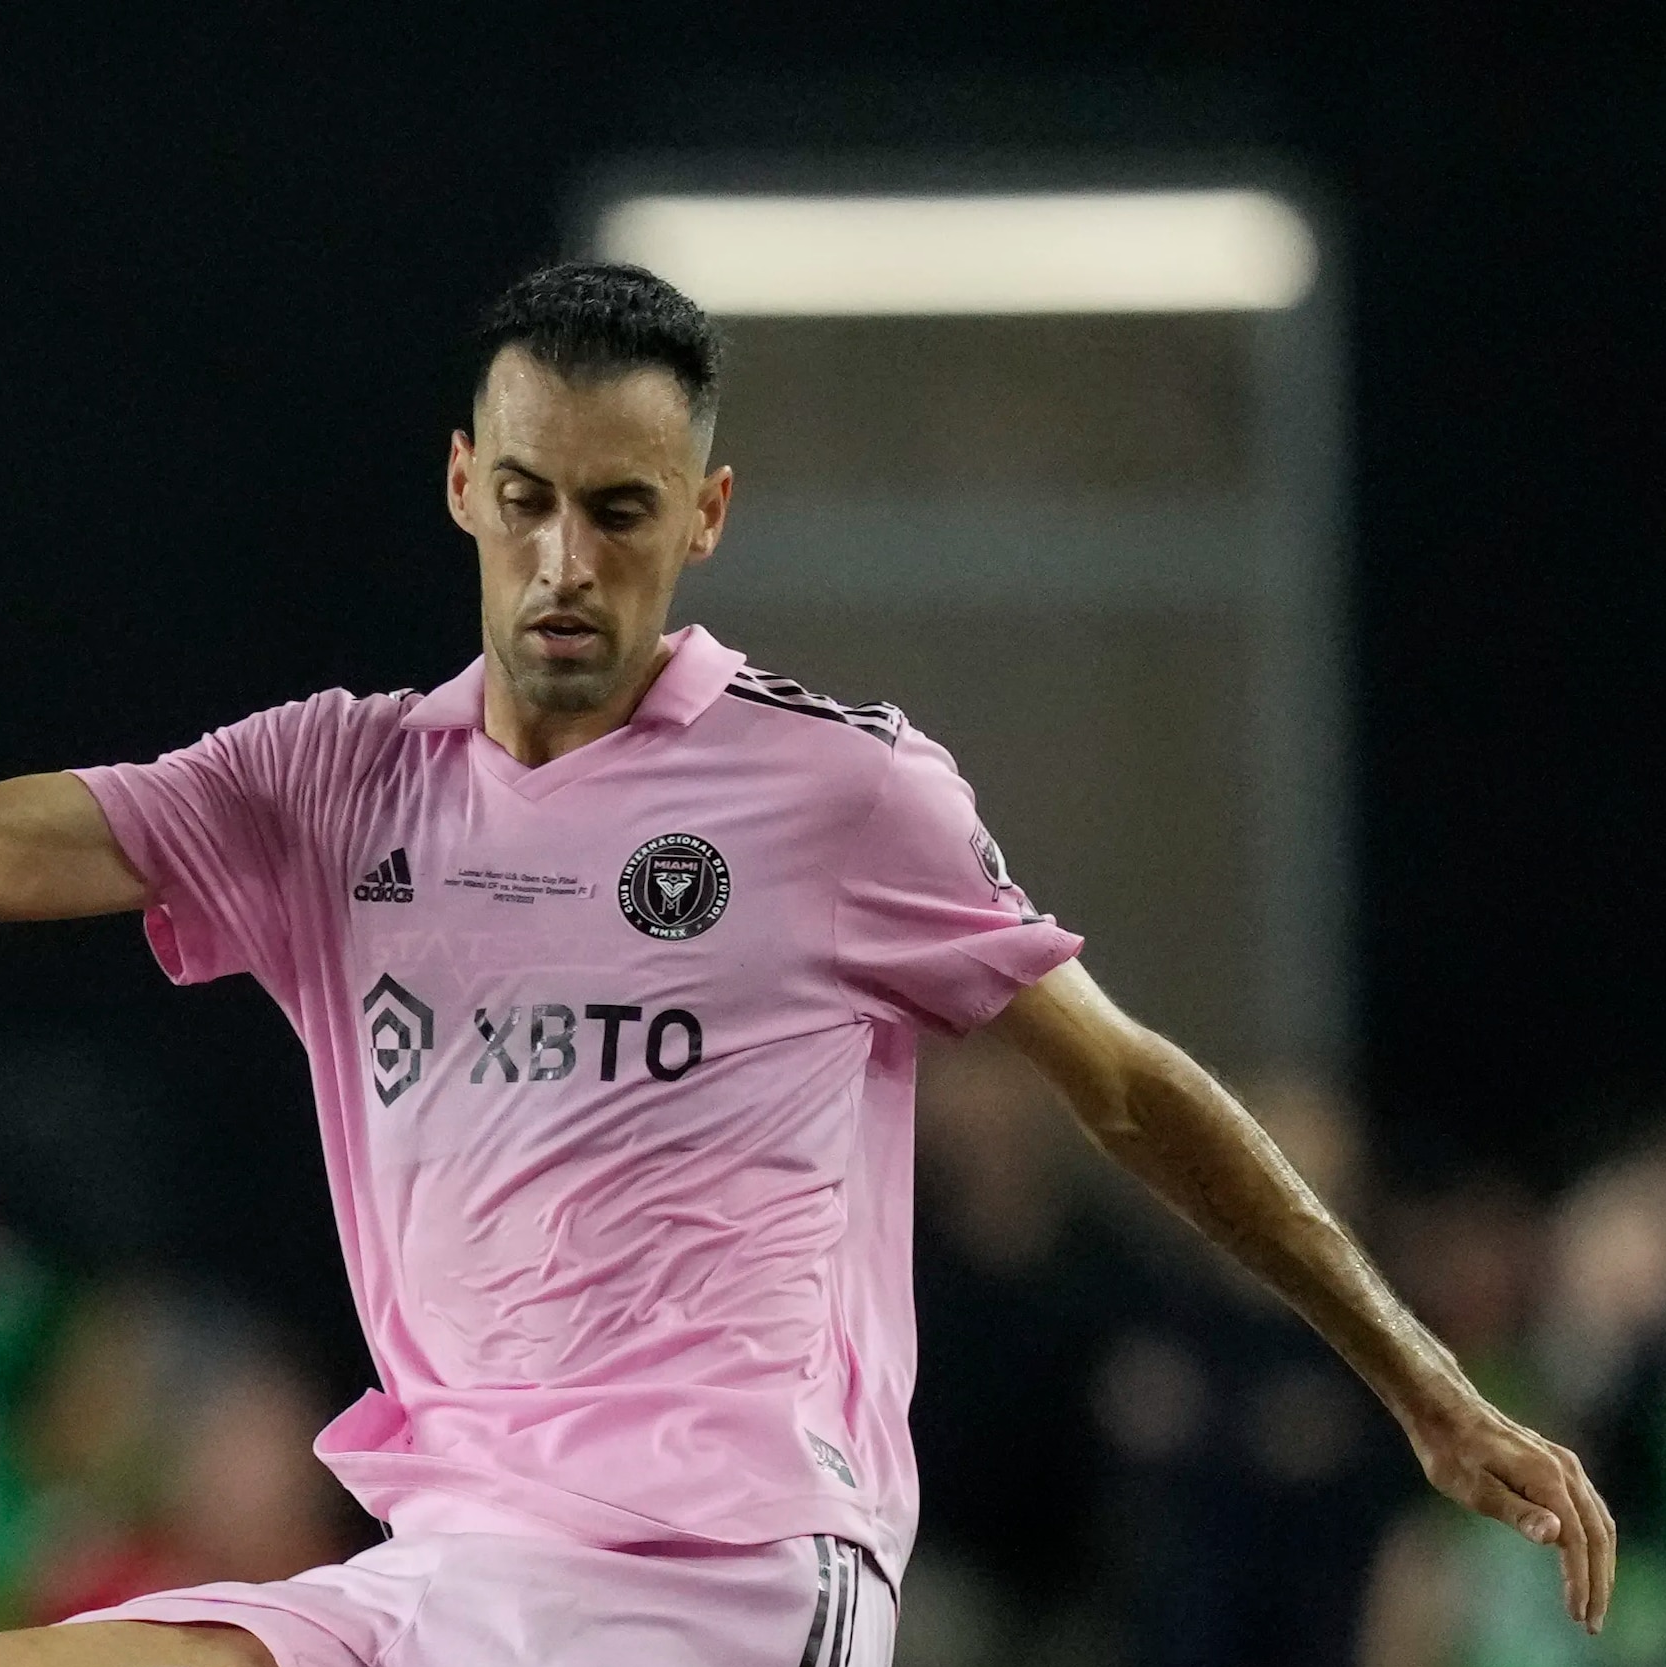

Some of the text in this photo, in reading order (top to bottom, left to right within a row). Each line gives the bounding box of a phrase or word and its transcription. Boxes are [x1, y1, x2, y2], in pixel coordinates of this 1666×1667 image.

[622, 836, 714, 880] INTERNACIONAL
[653, 860, 699, 872] MIAMI
[712, 858, 726, 874] DE
[354, 882, 414, 903] adidas
[620, 885, 634, 914] CLUB
[649, 926, 687, 938] MMXX
[470, 1003, 703, 1083] XBTO
